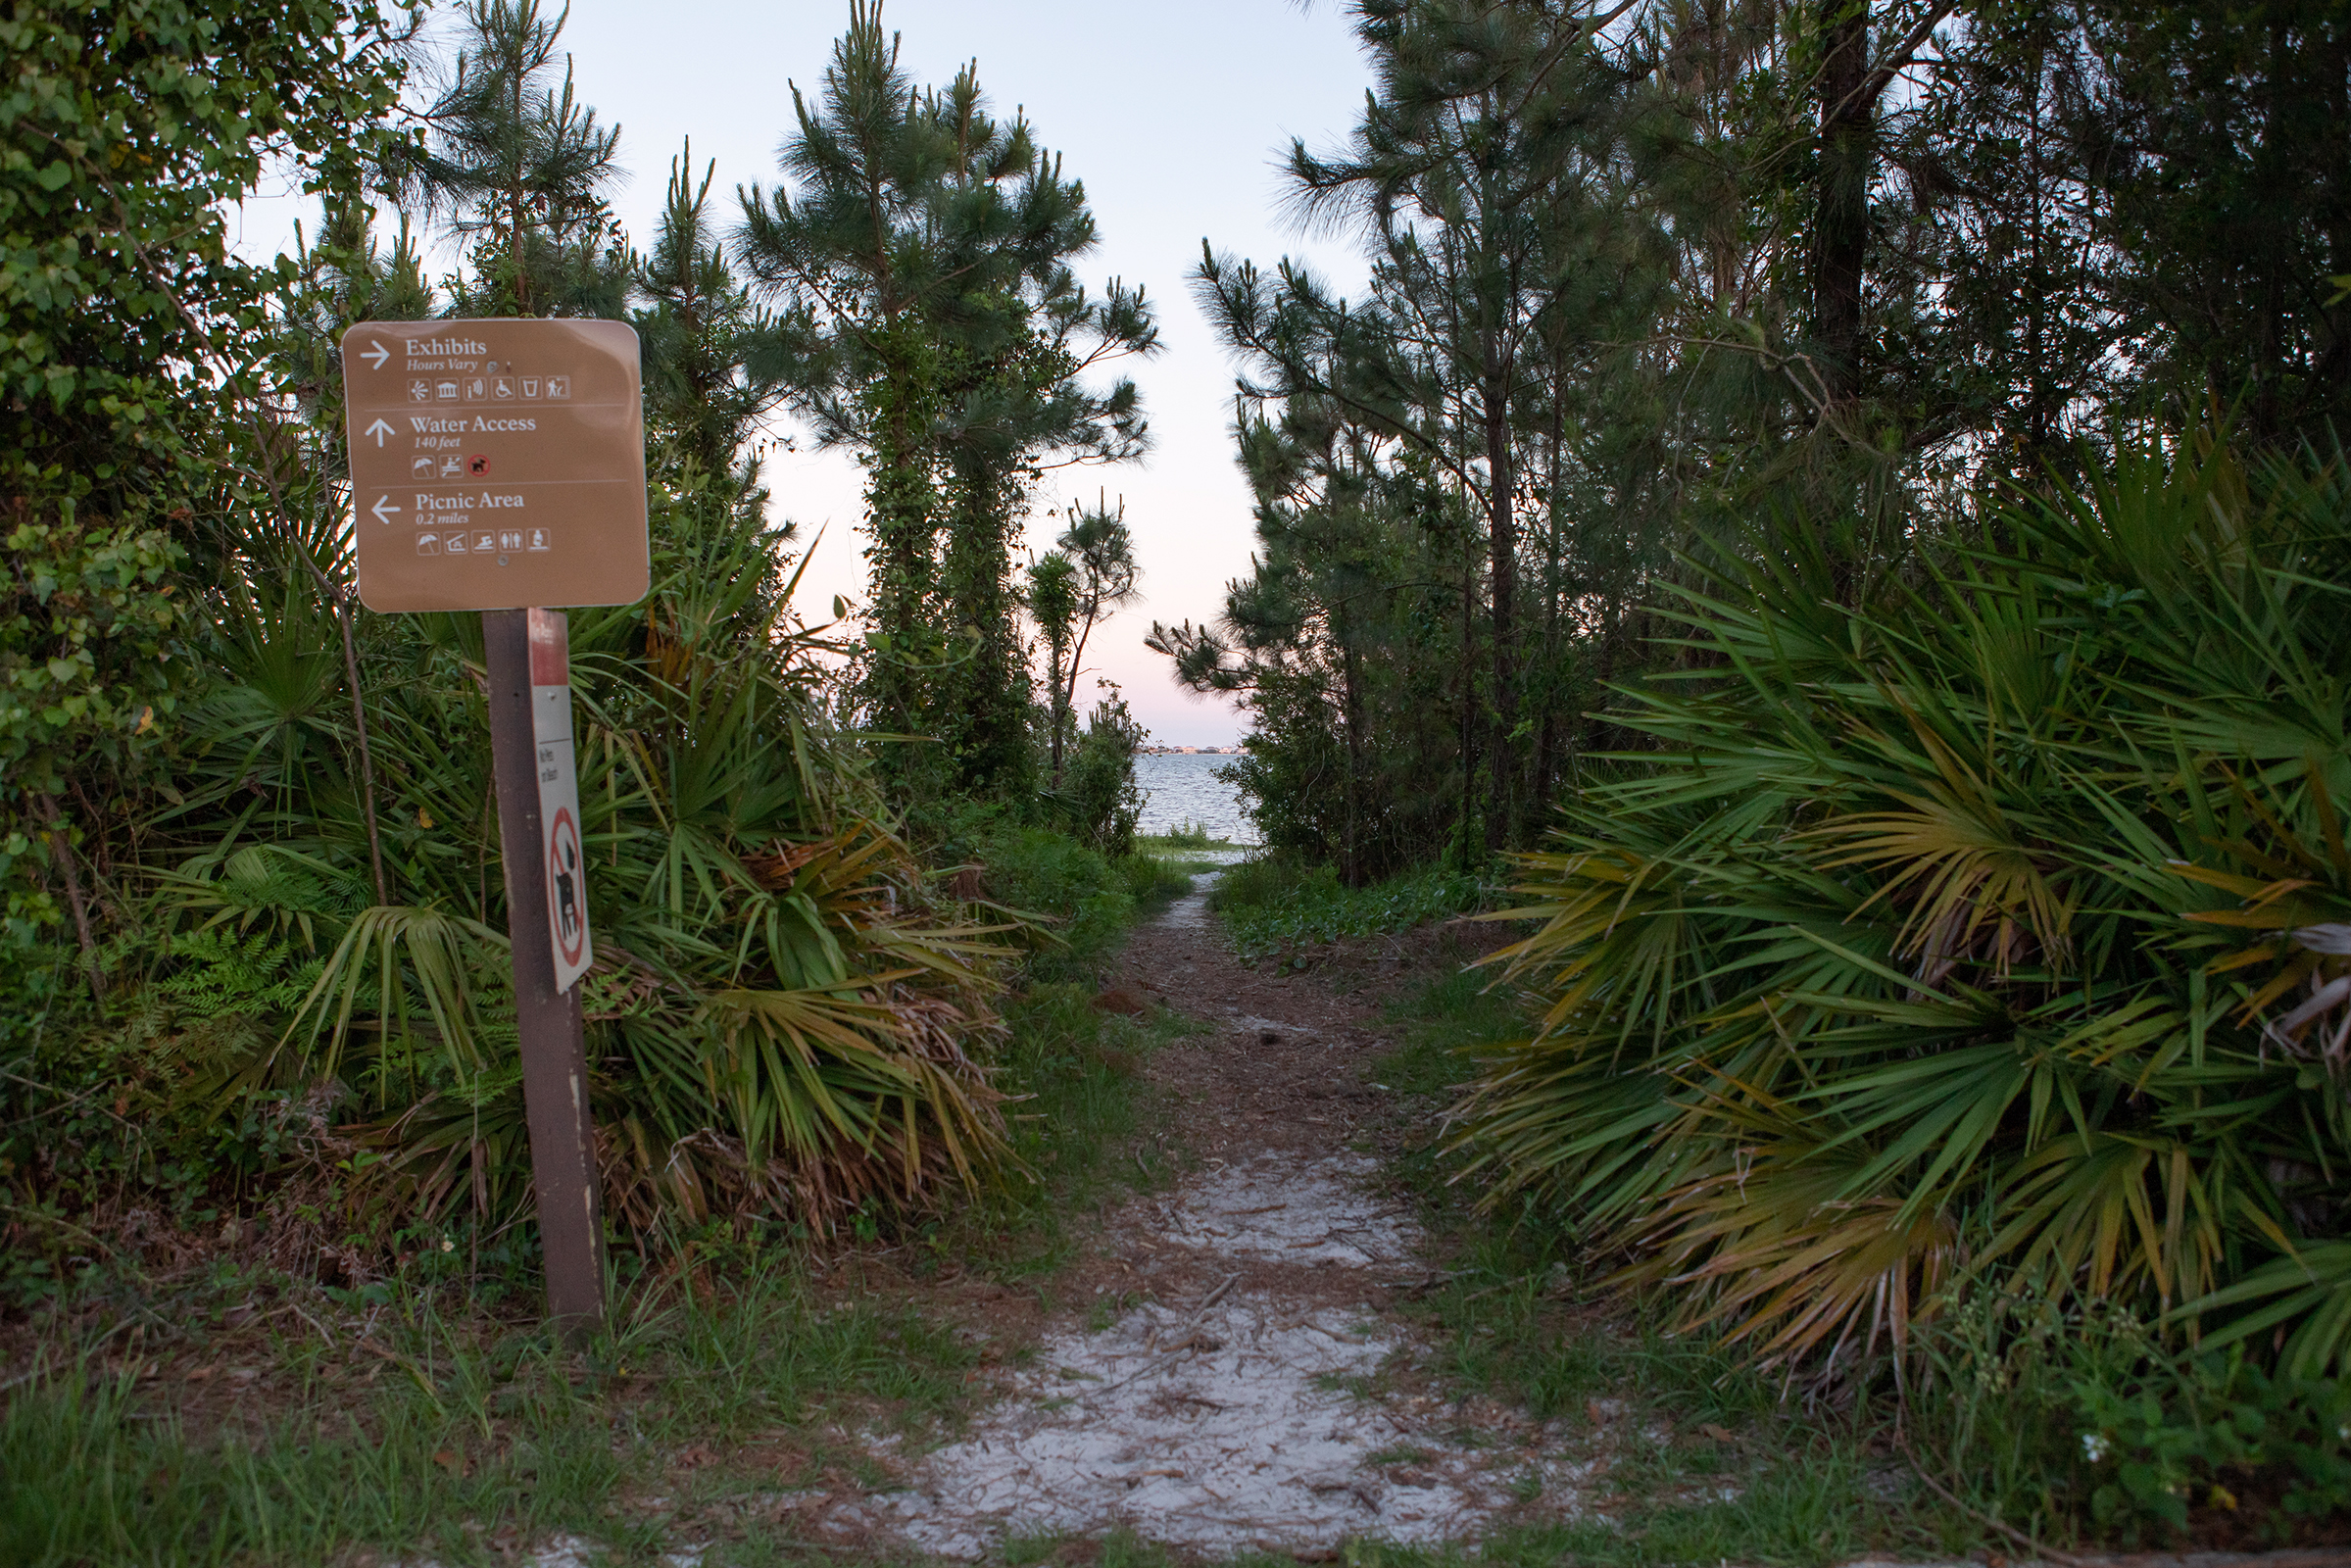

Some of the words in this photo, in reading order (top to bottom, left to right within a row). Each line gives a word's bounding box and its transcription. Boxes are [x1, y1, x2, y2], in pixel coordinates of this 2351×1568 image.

[406, 338, 487, 356] Exhibits
[407, 359, 445, 370] Hours
[448, 359, 478, 372] Vary
[410, 416, 467, 433] Water
[472, 416, 536, 431] Access
[415, 436, 437, 448] 140
[437, 435, 461, 451] feet
[416, 493, 474, 511] Picnic
[478, 492, 524, 509] Area
[416, 513, 434, 525] 0.2
[438, 513, 469, 524] miles
